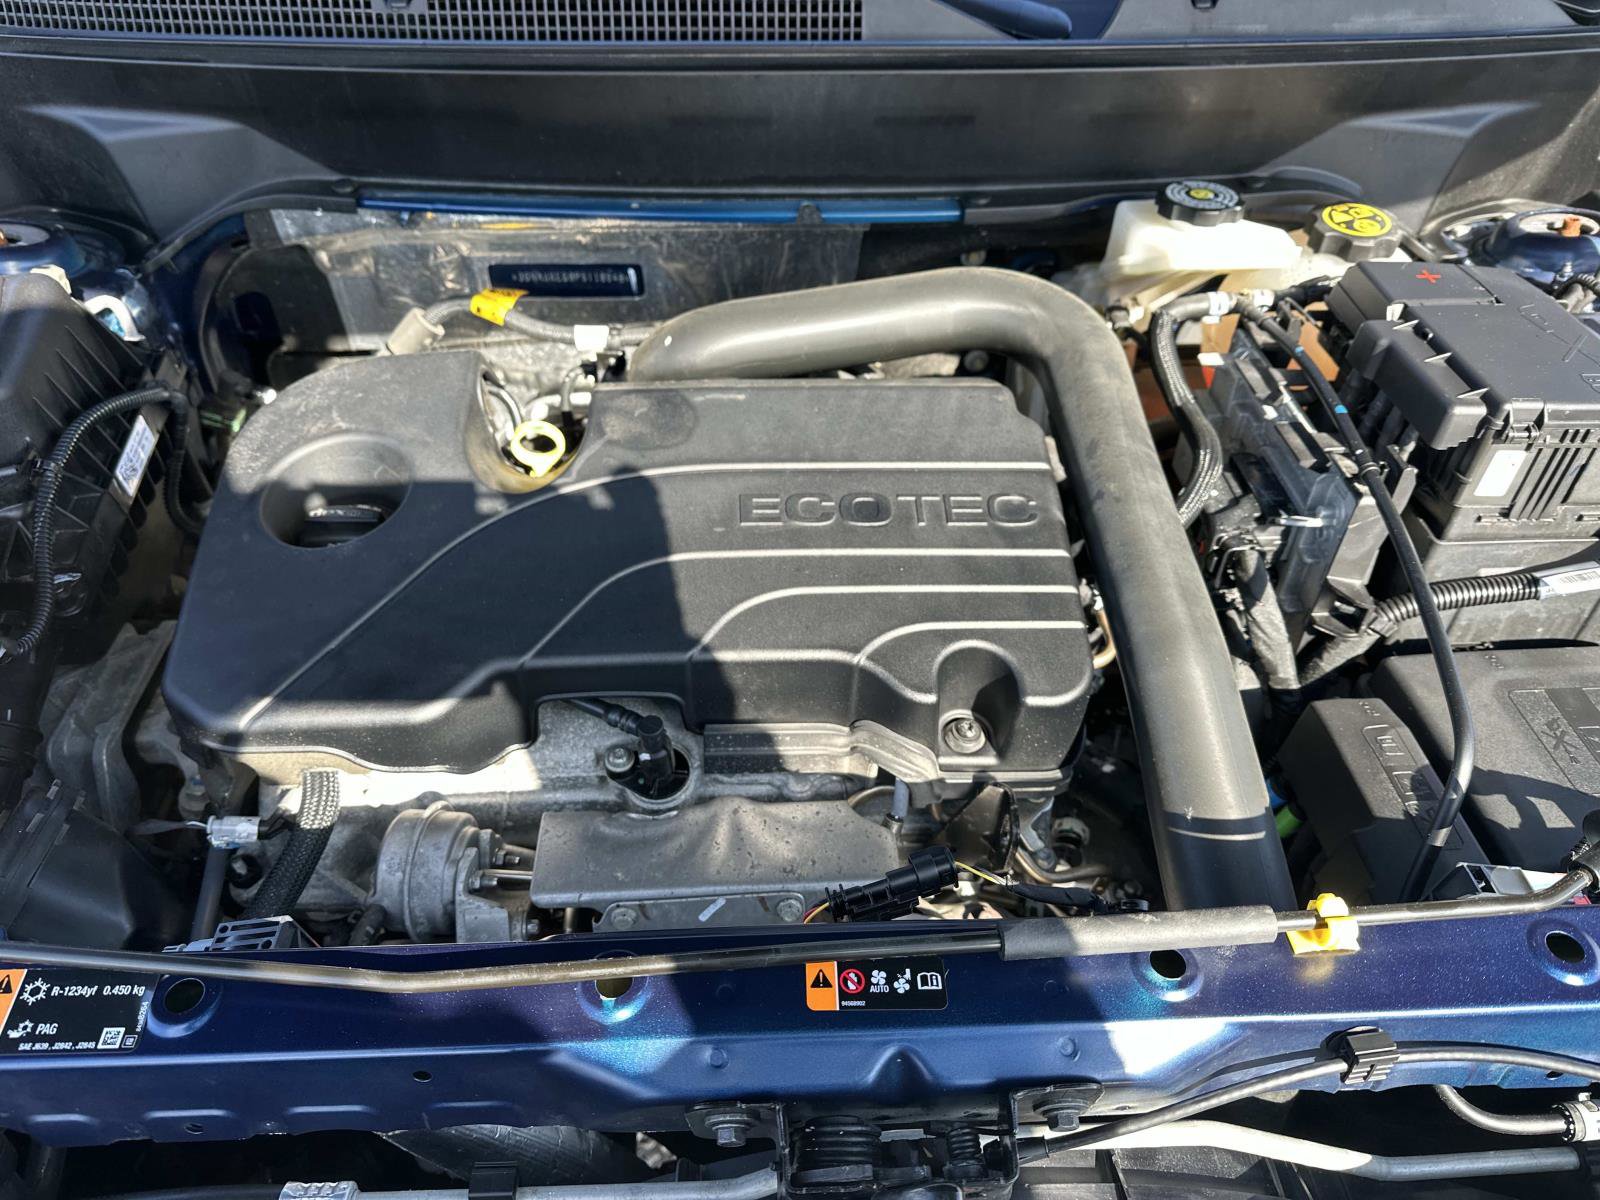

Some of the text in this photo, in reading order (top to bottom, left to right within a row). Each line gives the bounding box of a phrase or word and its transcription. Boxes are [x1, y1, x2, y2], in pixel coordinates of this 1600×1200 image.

[738, 493, 1039, 527] ECOTEC
[51, 985, 145, 998] R-1234yf 0.450 kg
[869, 985, 890, 993] AUTO
[36, 1023, 59, 1035] PAG
